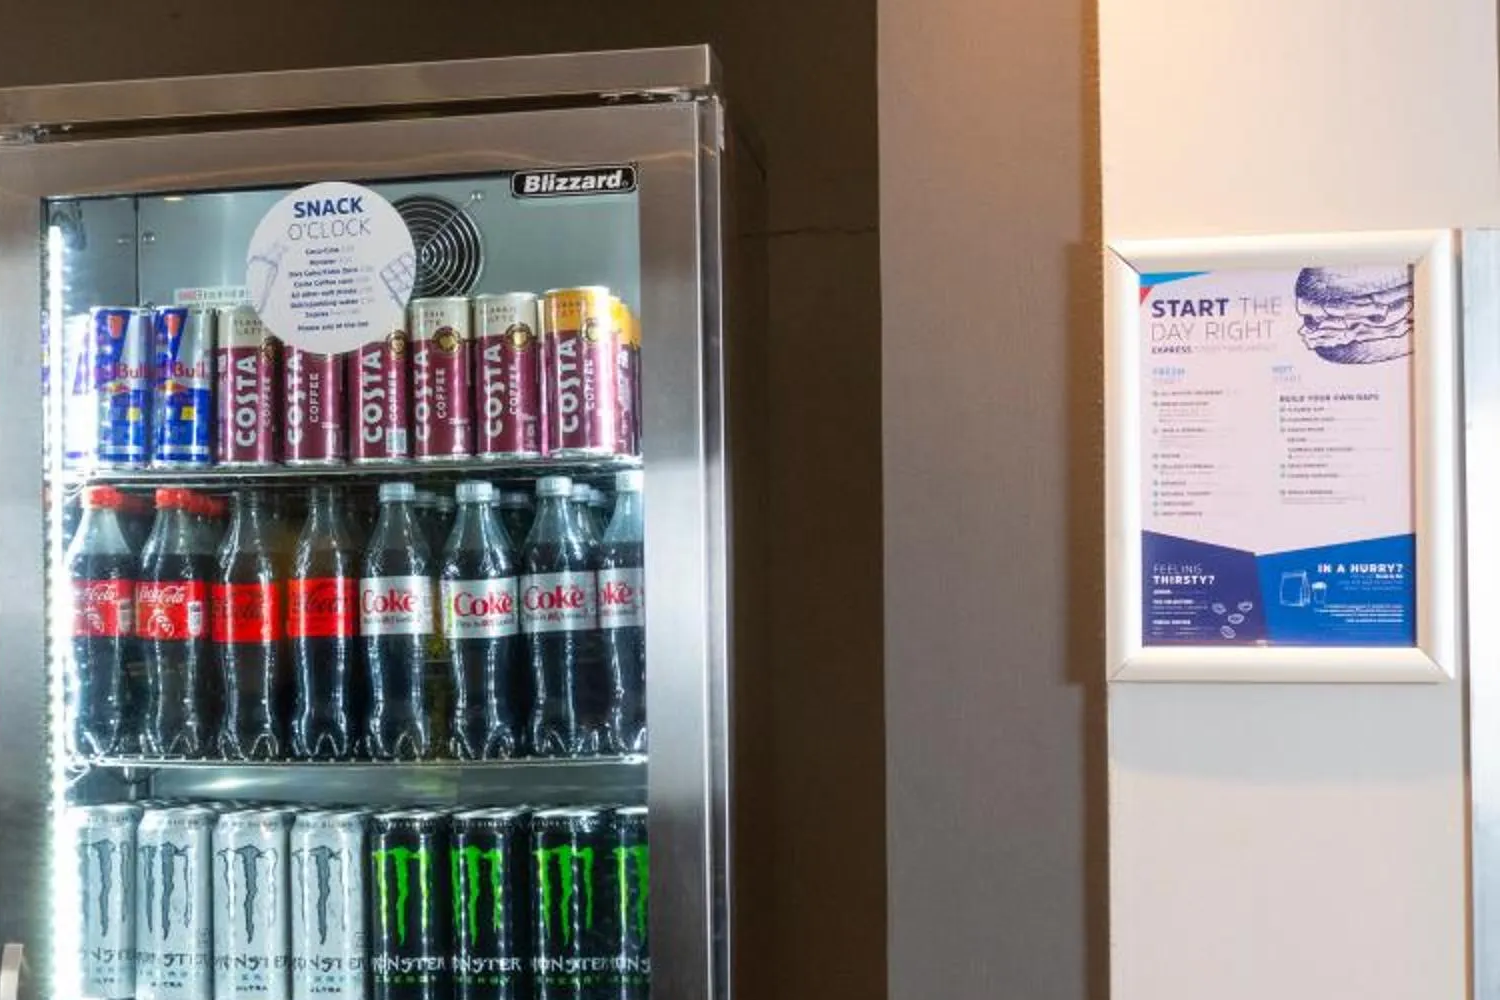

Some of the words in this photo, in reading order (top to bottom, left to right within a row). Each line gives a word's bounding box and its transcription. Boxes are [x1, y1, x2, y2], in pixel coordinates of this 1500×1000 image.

[524, 170, 622, 193] Blizzard
[293, 196, 364, 219] SNACK
[288, 218, 372, 241] O'CLOCK
[1151, 299, 1229, 319] START
[1239, 297, 1282, 317] THE
[1151, 322, 1196, 342] DAY
[1205, 320, 1275, 341] RIGHT
[286, 351, 306, 447] COSTA
[309, 372, 320, 423] COFFEE
[362, 350, 386, 443] COSTA
[413, 349, 434, 442] COSTA
[435, 367, 447, 419] COFFEE
[483, 343, 505, 438] COSTA
[509, 364, 520, 416] COFFEE
[559, 337, 581, 434] COSTA
[235, 354, 259, 447] COSTA
[1153, 563, 1203, 575] FEELING
[1153, 575, 1216, 585] THIRSTY?
[1337, 563, 1346, 574] A
[1350, 563, 1404, 574] HURRY?
[362, 586, 417, 614] Coke
[453, 590, 513, 617] Coke
[524, 584, 586, 611] Coke
